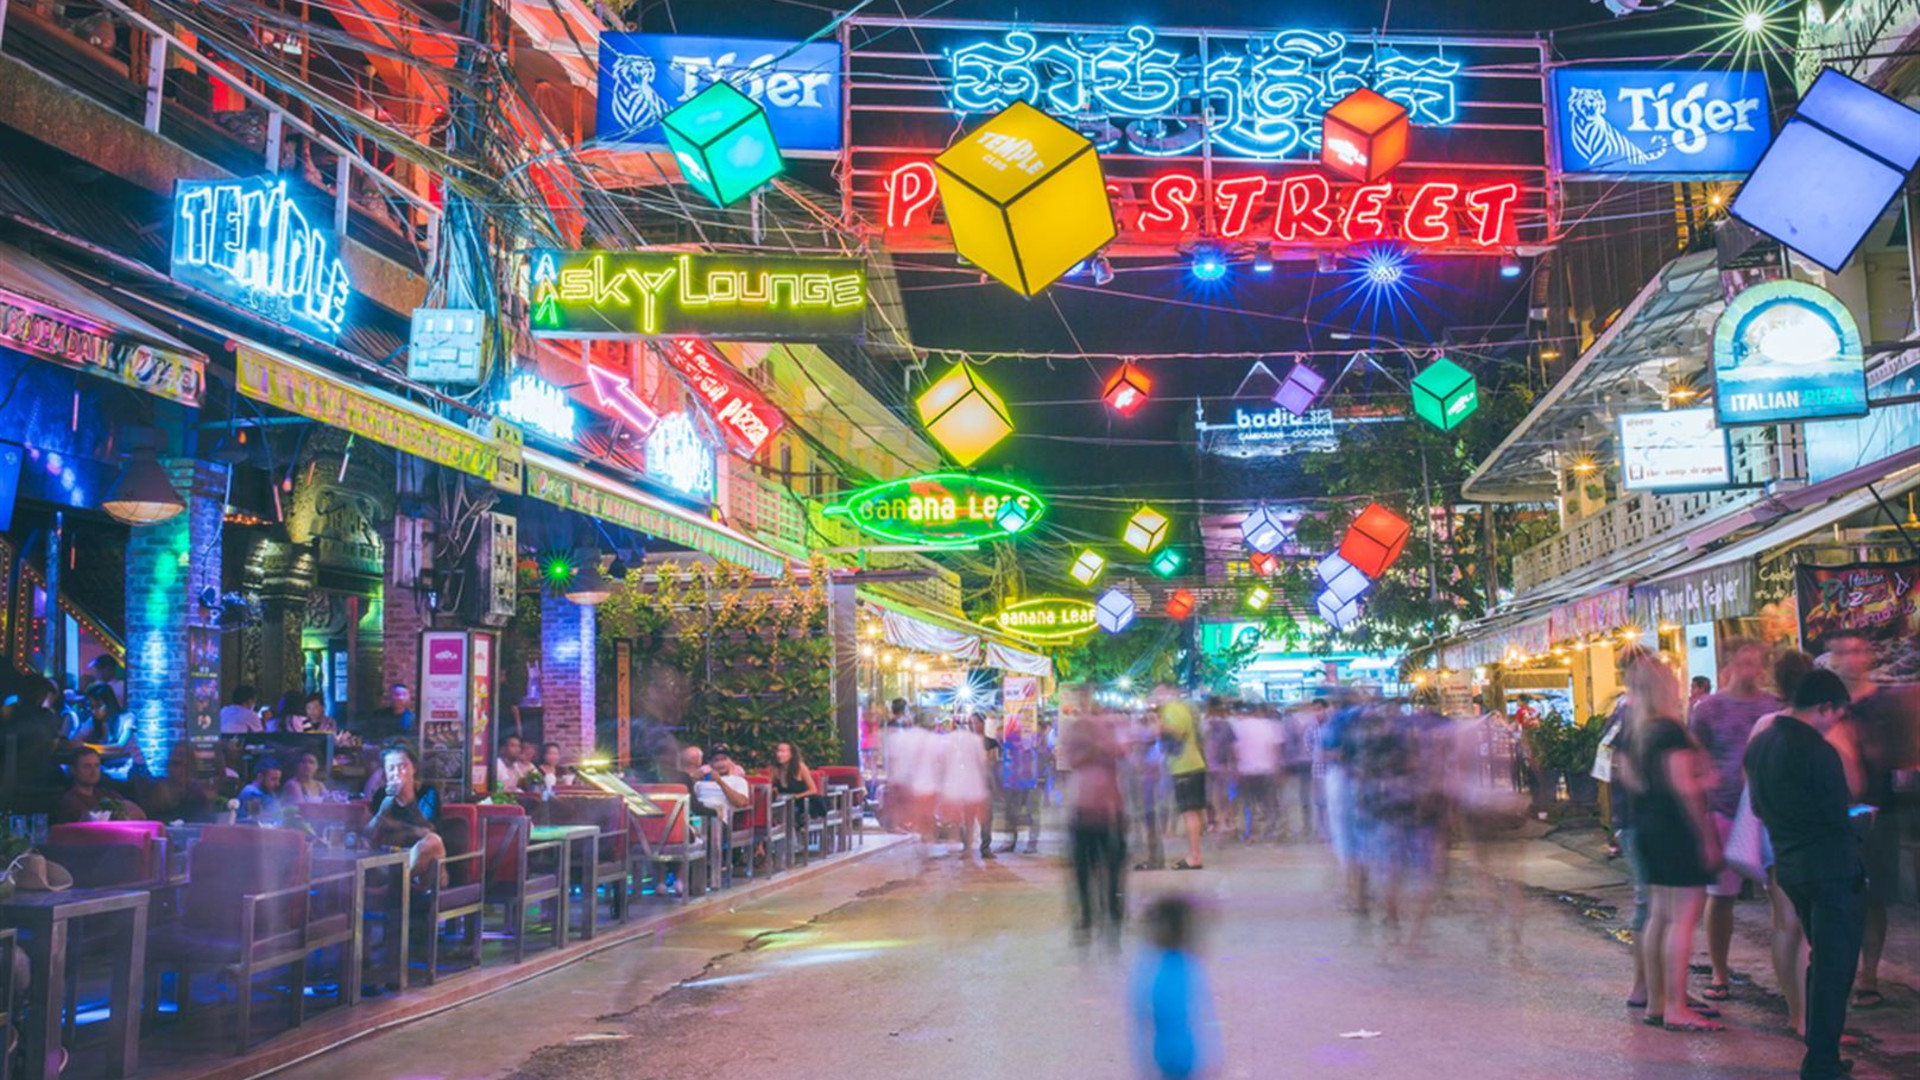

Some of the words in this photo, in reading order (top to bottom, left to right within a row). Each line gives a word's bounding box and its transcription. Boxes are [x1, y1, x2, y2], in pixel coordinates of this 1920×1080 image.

[1617, 81, 1760, 155] Tiger
[976, 130, 1045, 176] TEMPLE
[1137, 173, 1518, 247] STREET
[717, 397, 770, 447] pizza
[1730, 390, 1800, 413] ITALIAN
[1803, 386, 1857, 407] PIZZA
